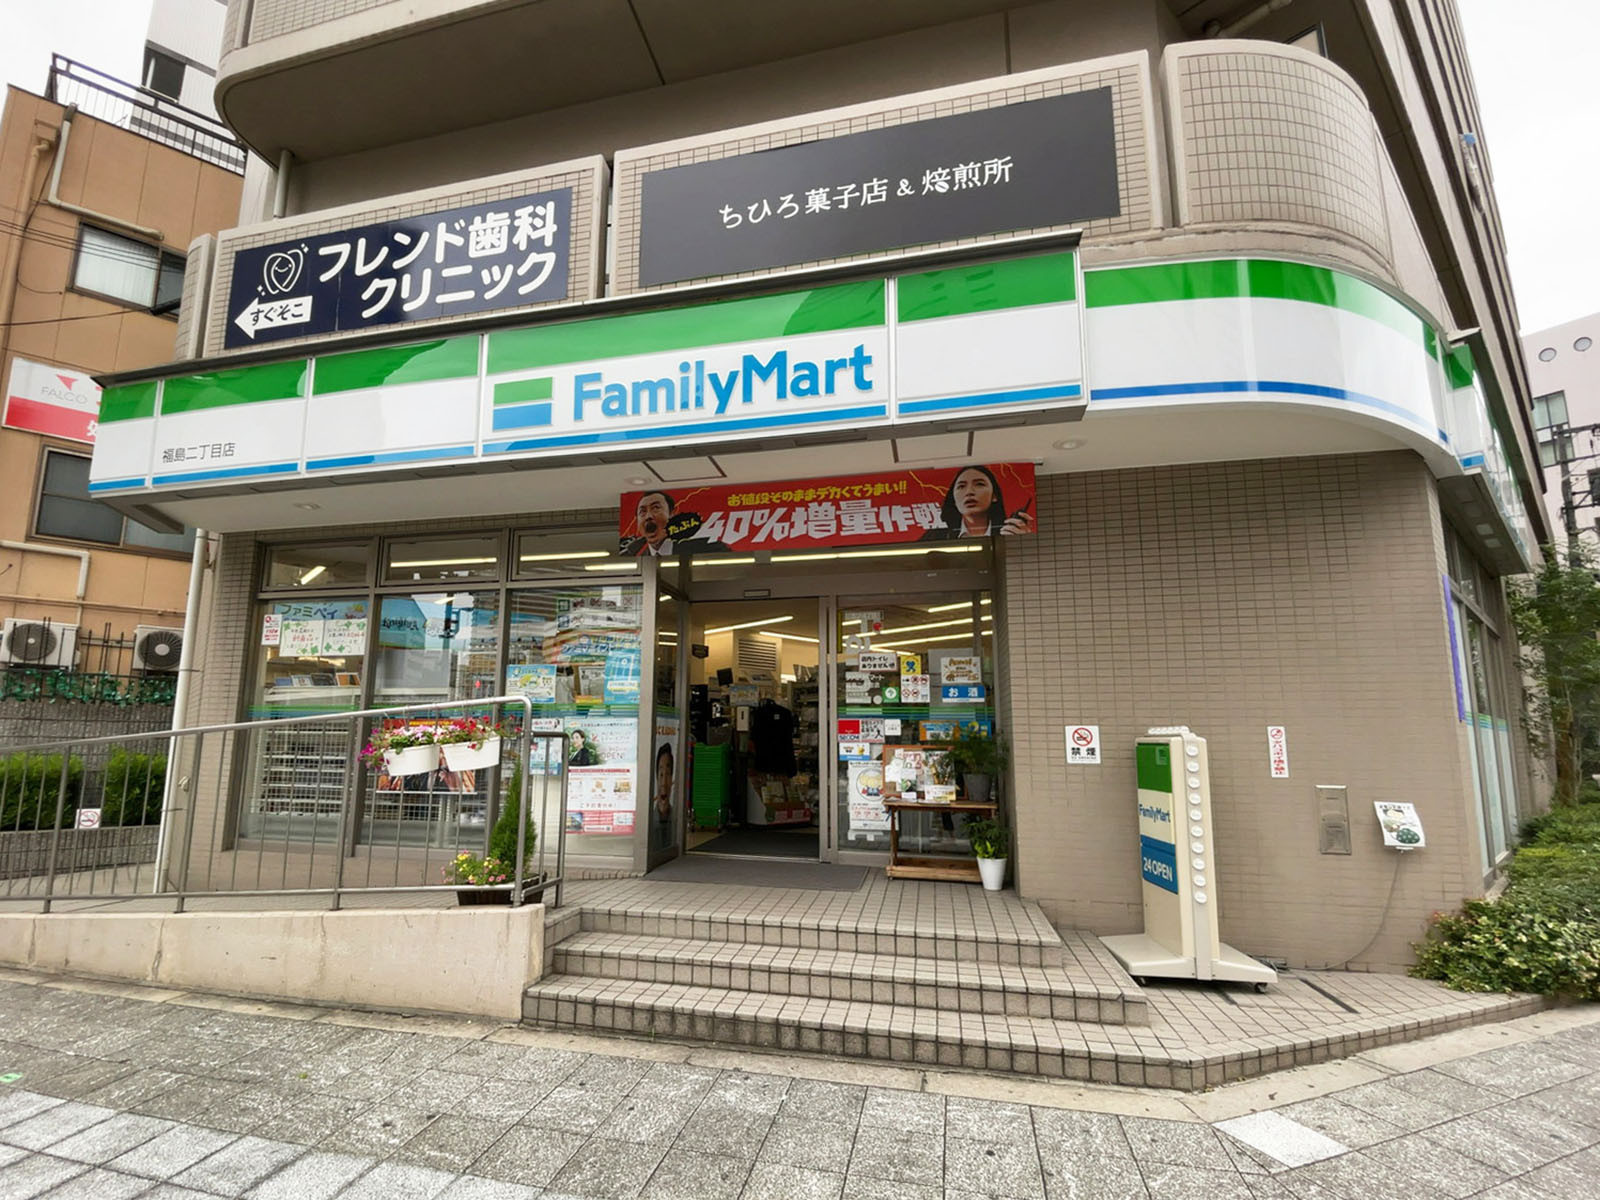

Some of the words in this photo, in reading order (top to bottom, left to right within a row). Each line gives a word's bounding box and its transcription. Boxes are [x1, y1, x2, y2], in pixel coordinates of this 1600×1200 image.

[718, 177, 890, 230] ちひろ菓子店
[896, 178, 915, 197] &
[921, 156, 1014, 196] 焙煎所
[318, 200, 558, 283] フレンド歯科
[360, 251, 557, 319] クリニック
[249, 301, 305, 327] すぐそこ
[573, 343, 874, 422] FamilyMart
[40, 386, 88, 405] FALCO
[162, 442, 236, 463] 福島二丁目店
[667, 519, 700, 536] たぶん
[1071, 746, 1097, 756] 禁煙
[1139, 804, 1171, 824] FamilyMart
